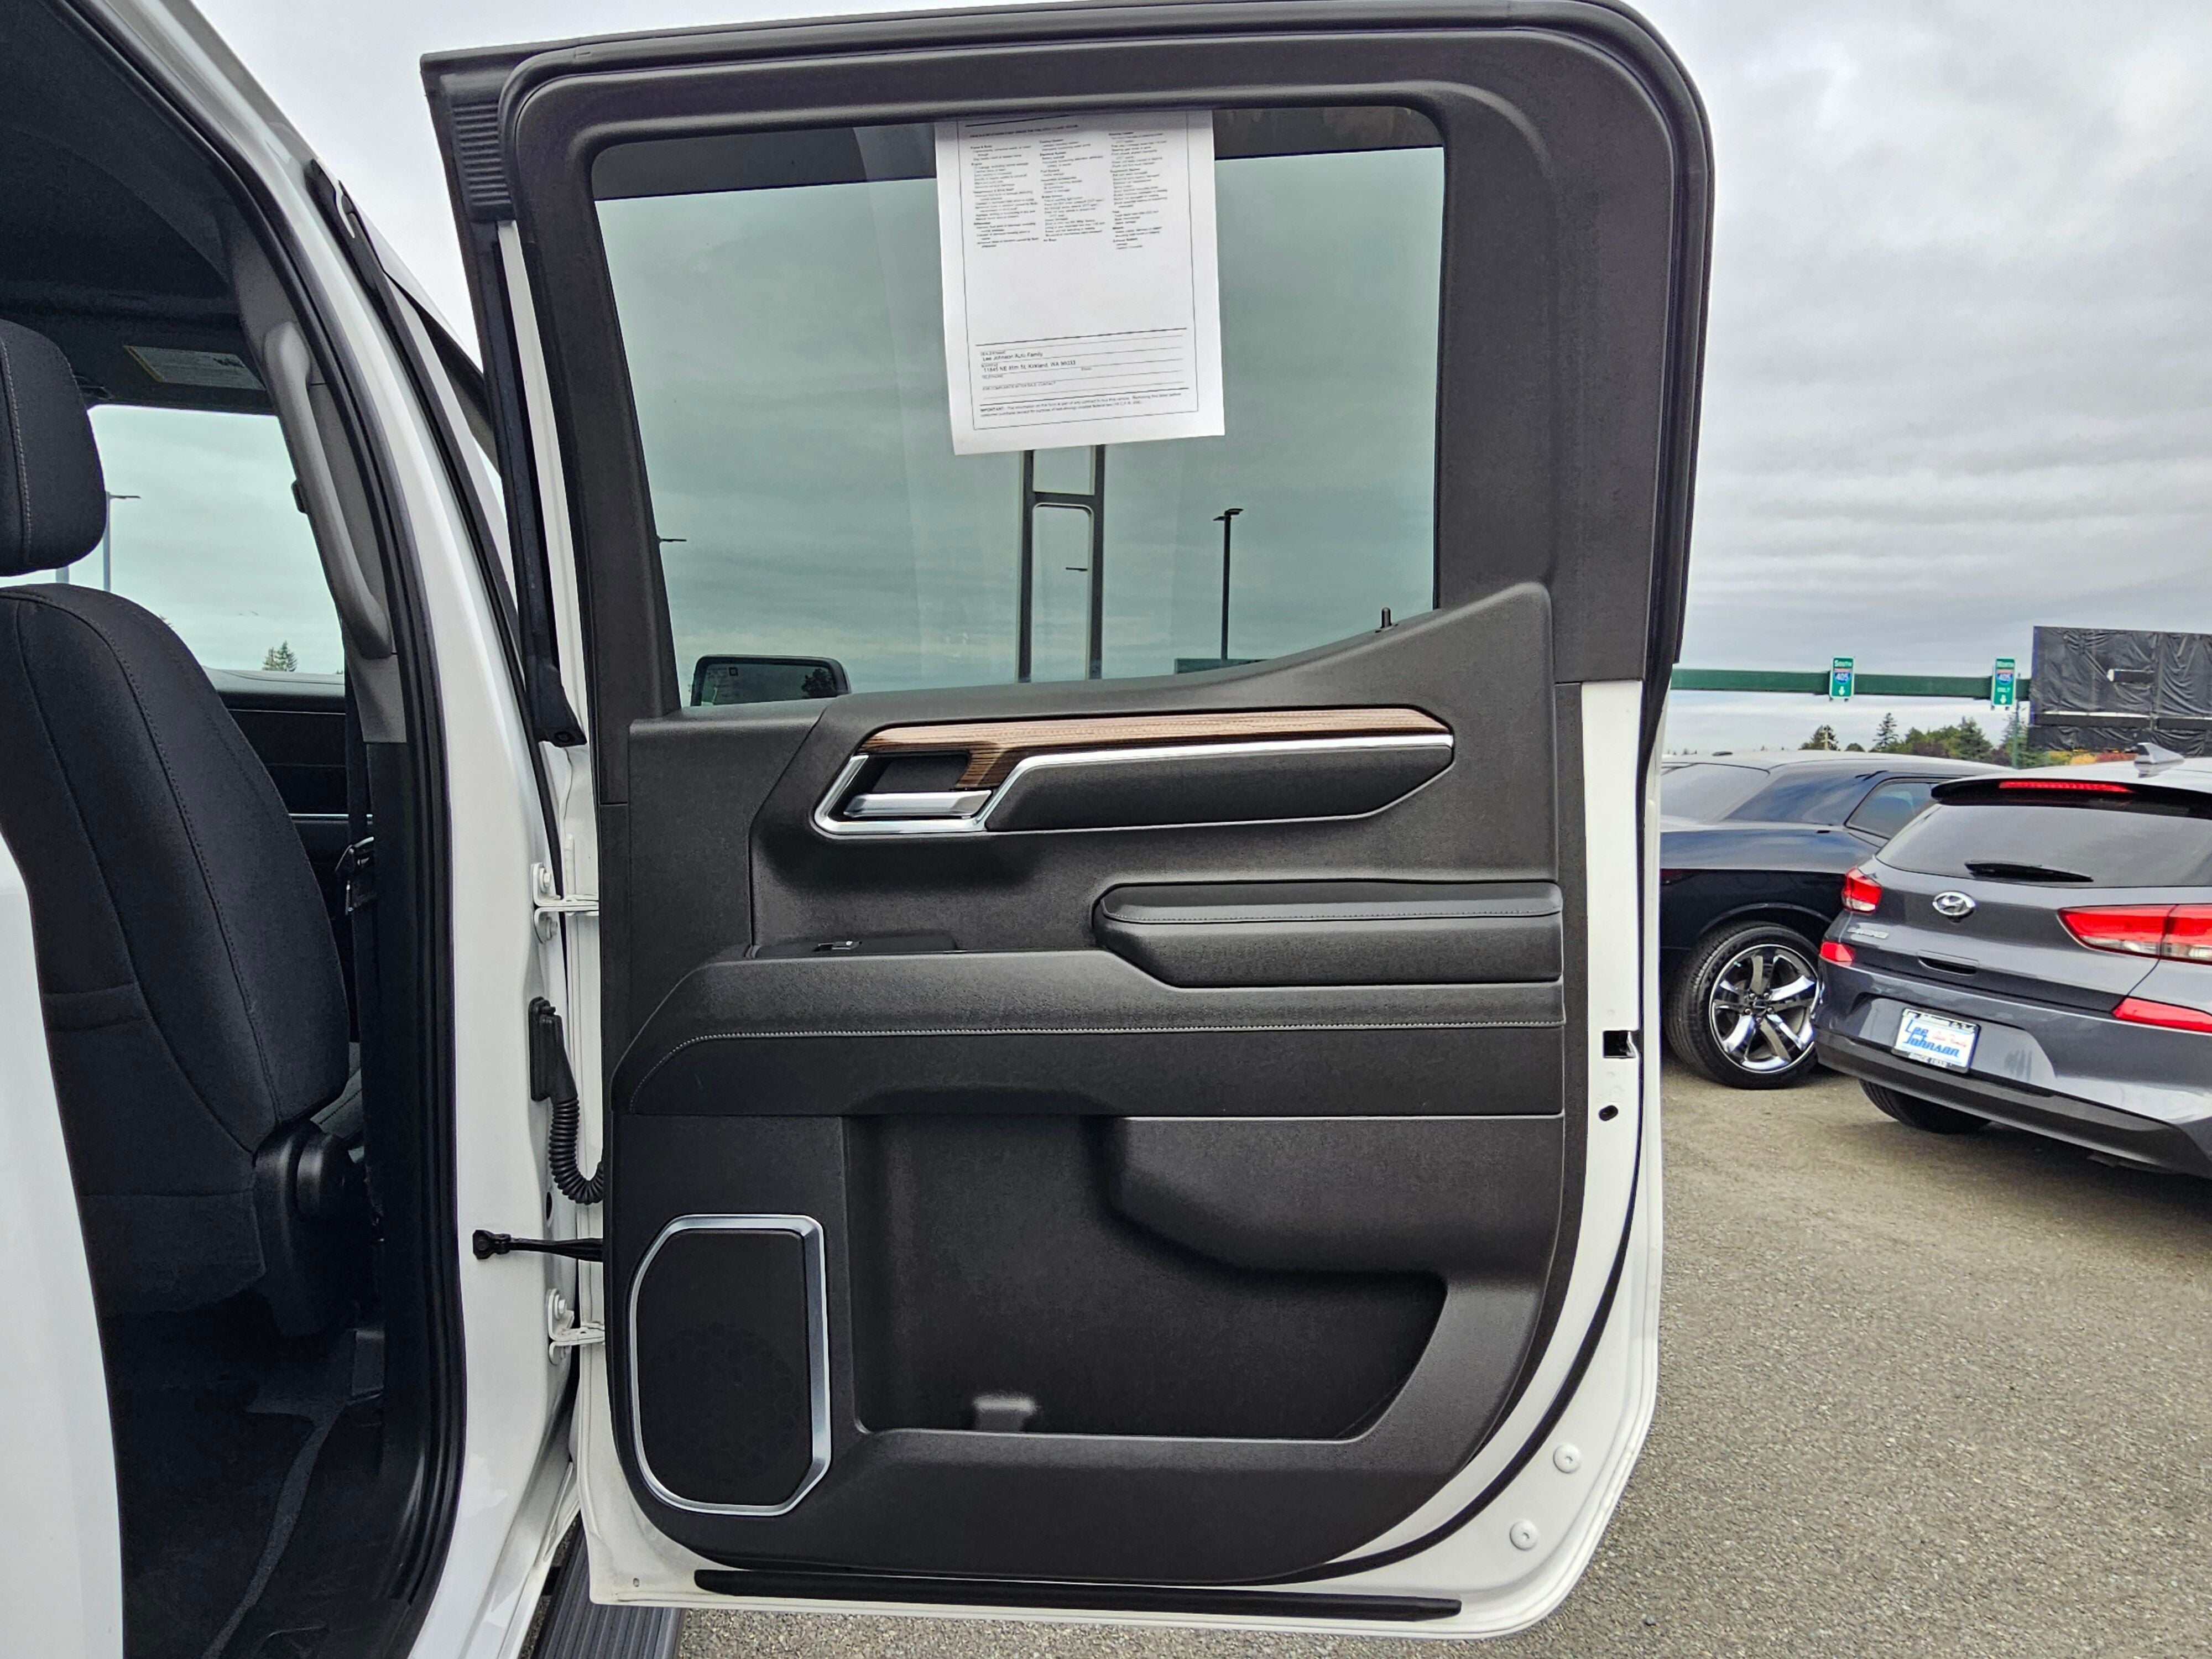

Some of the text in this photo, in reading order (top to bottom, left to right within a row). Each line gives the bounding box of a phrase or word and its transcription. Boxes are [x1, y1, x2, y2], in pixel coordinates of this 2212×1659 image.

[1835, 672, 1849, 681] 405
[1999, 674, 2011, 682] 405
[1905, 1019, 1929, 1036] Lee
[1902, 1031, 1960, 1058] Johnson
